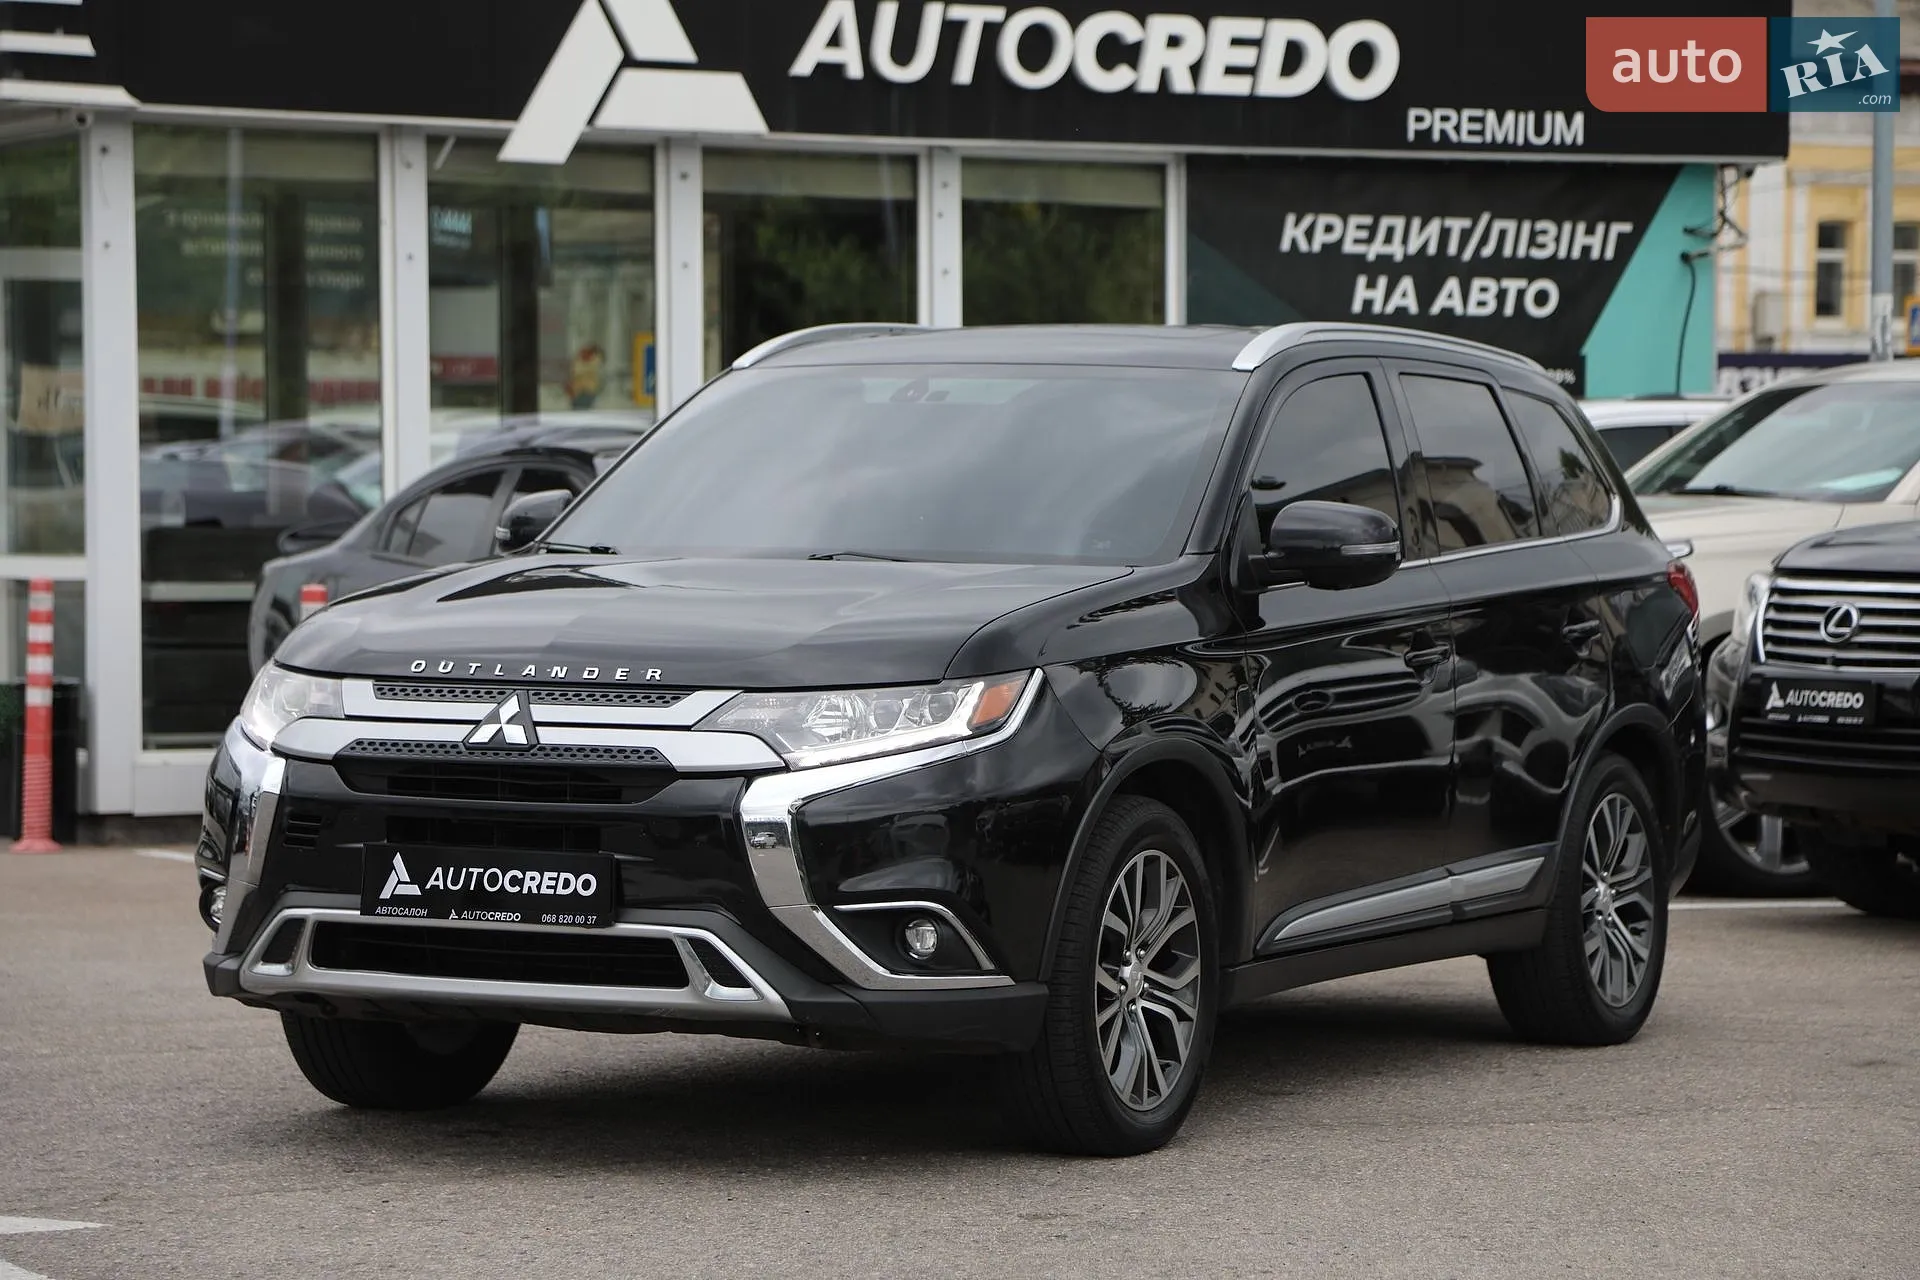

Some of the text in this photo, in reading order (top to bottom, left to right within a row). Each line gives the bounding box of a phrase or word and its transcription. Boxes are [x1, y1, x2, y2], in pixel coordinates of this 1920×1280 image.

[788, 0, 1400, 101] AUTOCREDO
[1406, 107, 1585, 146] PREMIUM
[1279, 211, 1635, 263] КРЕДИТ/ЛІЗІНГ
[1351, 274, 1560, 319] НА АВТО
[410, 659, 663, 681] OUTLANDER
[1785, 688, 1865, 710] AUTOCREDO
[424, 866, 598, 897] AUTOCREDO
[375, 906, 428, 918] АВТОСАЛОН
[461, 910, 522, 922] AUTOCREDO
[541, 914, 597, 925] 068 820 00 37
